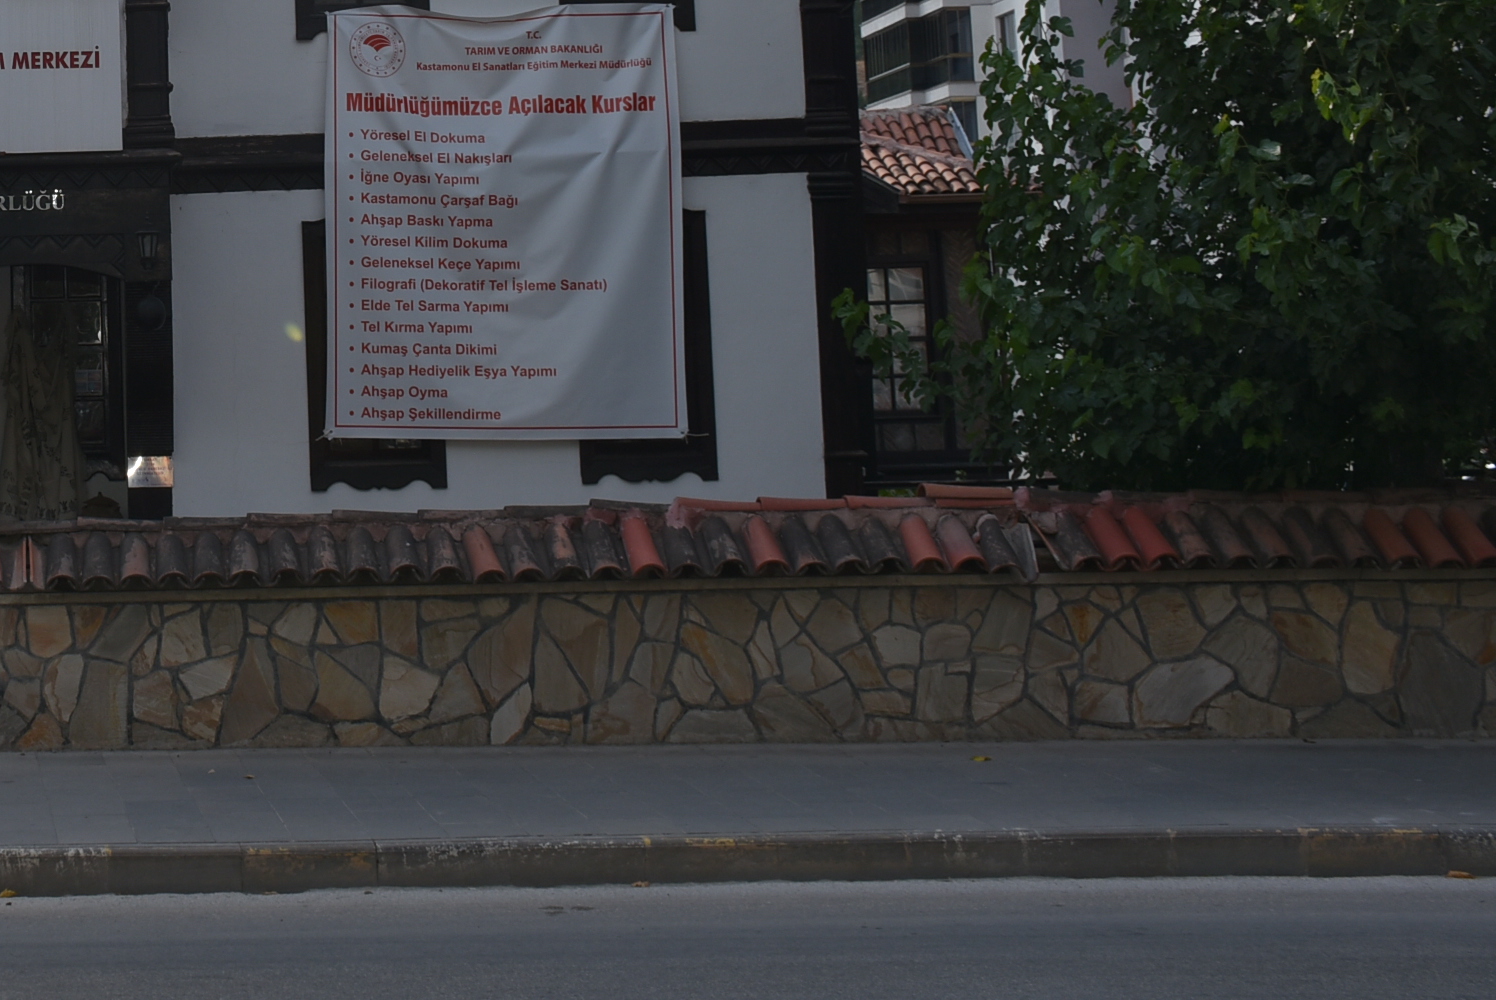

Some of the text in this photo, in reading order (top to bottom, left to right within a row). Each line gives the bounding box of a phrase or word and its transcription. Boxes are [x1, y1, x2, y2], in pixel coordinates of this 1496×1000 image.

[526, 31, 541, 40] T.C.
[11, 45, 100, 69] MERKEZİ
[465, 43, 602, 56] TARIM VE ORMAN BAKANLIĞI
[416, 57, 652, 71] Kastamonu El Sanatları Eğitim Merkezi Müdürlüğü
[346, 92, 655, 118] Müdürlüğümüzce Açılacak Kurslar
[361, 129, 485, 144] Yöresel El Dokuma
[361, 150, 512, 166] Geleneksel El Nakışları
[361, 168, 479, 187] İğne Oyası Yapımı
[361, 192, 518, 208] Kastamonu Çarşaf Bağı
[361, 214, 493, 229] Ahşap Baskı Yapma
[361, 235, 508, 249] Yöresel Kilim Dokuma
[361, 257, 520, 272] Geleneksel Keçe Yapımı
[361, 277, 607, 294] Filografi (Dekoratif Tel İşleme Sanatı)
[361, 300, 508, 315] Elde Tel Sarma Yapımı
[361, 321, 472, 335] Tel Kırma Yapımı
[361, 343, 497, 358] Kumaş Çanta Dikimi
[361, 364, 556, 379] Ahşap Hediyelik Eşya Yapımı
[361, 386, 448, 400] Ahşap Oyma
[361, 408, 501, 422] Ahşap Şekillendirme
